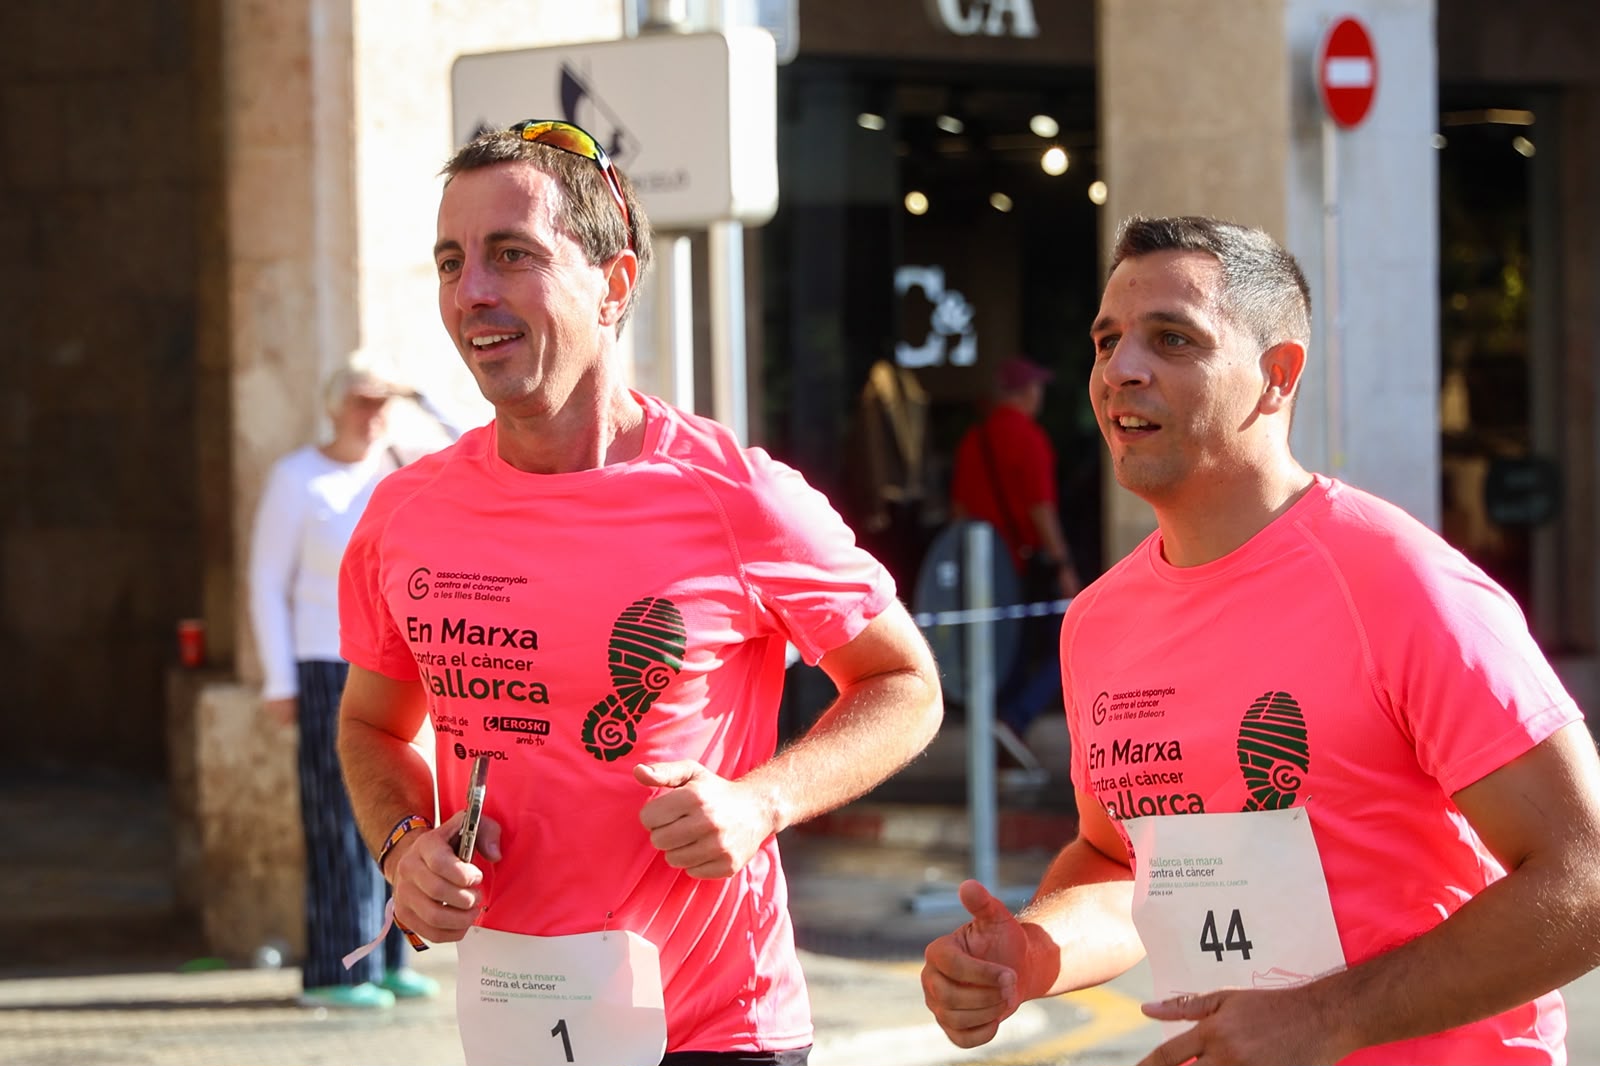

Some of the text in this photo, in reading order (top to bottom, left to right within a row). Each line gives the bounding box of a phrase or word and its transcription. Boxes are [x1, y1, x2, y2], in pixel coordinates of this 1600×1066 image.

[436, 571, 528, 586] associació espanyola
[434, 581, 461, 589] contra
[472, 582, 504, 592] càncer
[441, 591, 452, 599] les
[475, 592, 510, 602] Balears
[407, 617, 538, 650] En Marxa
[451, 652, 467, 666] el
[471, 653, 534, 671] càncer
[1142, 686, 1175, 698] espanyola
[1110, 702, 1129, 711] contra
[1130, 700, 1136, 708] el
[503, 719, 547, 733] EROSKI
[1090, 738, 1182, 770] En Marxa
[1119, 772, 1133, 788] el
[1135, 771, 1183, 786] càncer
[1099, 789, 1206, 820] allorca
[1183, 857, 1194, 866] en
[1196, 857, 1223, 865] marxa
[1175, 867, 1184, 877] el
[1186, 867, 1215, 877] càncer
[1200, 909, 1253, 962] 44
[481, 966, 517, 980] Mallorca
[535, 974, 566, 982] marxa
[481, 978, 556, 991] contra el càncer
[551, 1019, 575, 1063] 1
